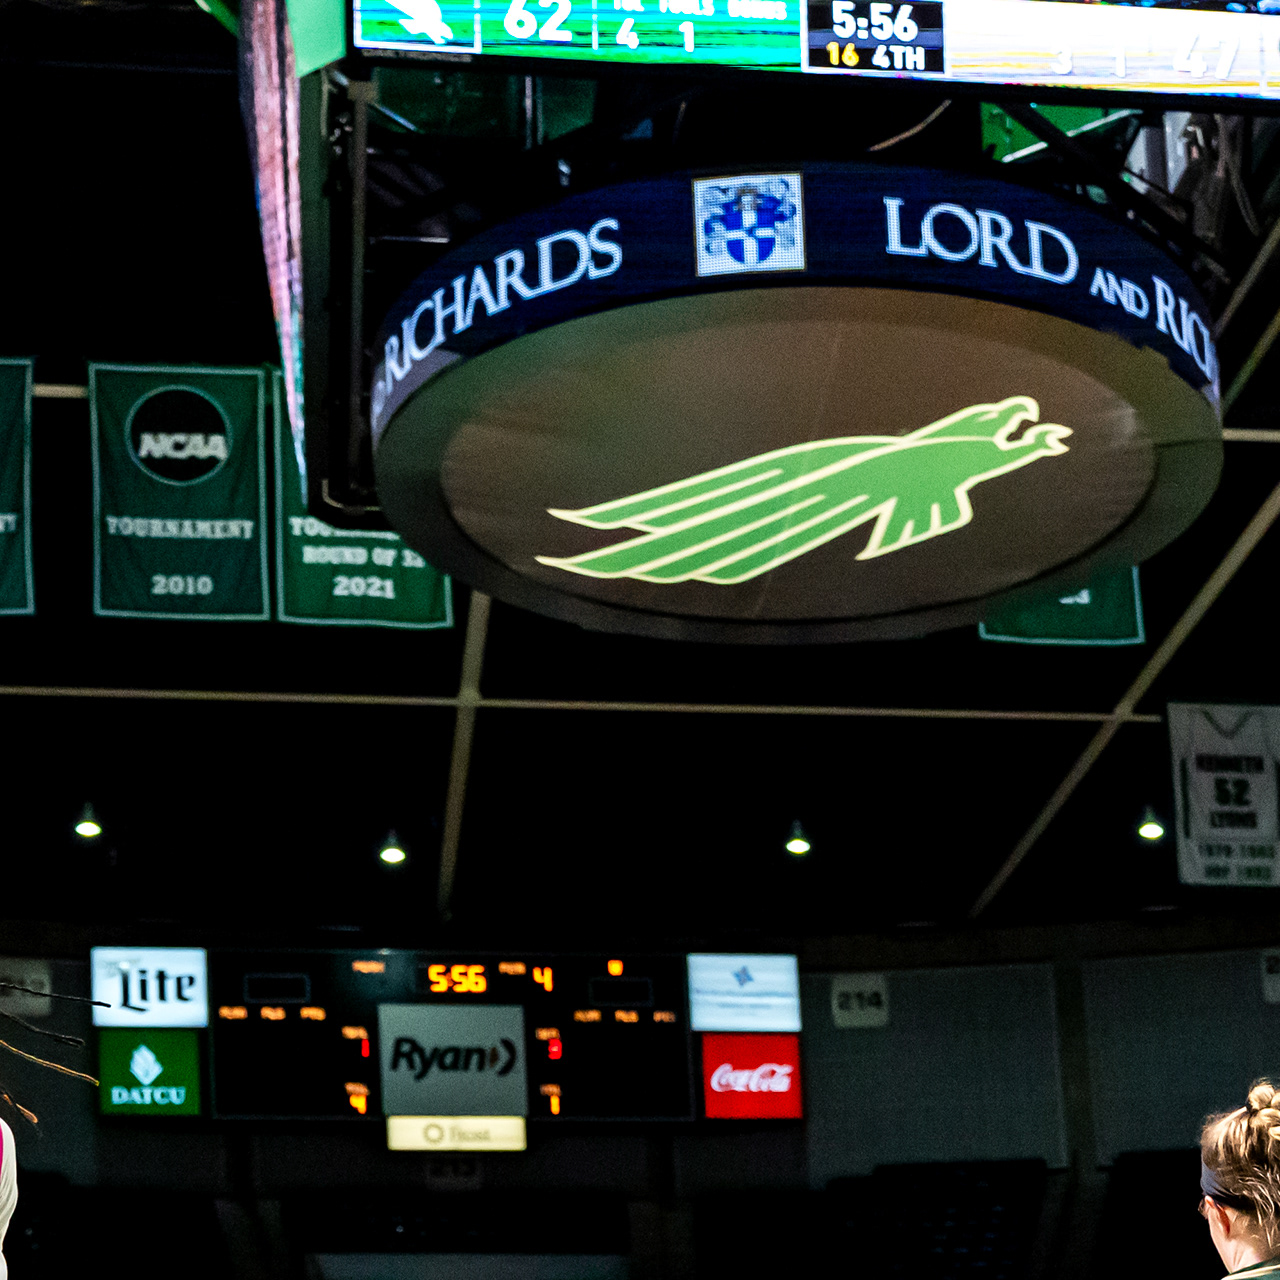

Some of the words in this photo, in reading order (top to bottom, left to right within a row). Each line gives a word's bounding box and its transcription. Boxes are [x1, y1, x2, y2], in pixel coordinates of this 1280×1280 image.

[503, 0, 572, 42] 62
[616, 17, 639, 49] 4
[678, 21, 694, 52] 1
[832, 1, 918, 42] 5:56
[826, 42, 859, 66] 16
[873, 43, 925, 70] 4TH
[883, 196, 1079, 285] LORD
[1090, 267, 1149, 319] AND
[384, 217, 622, 393] RICHARDS
[139, 432, 228, 459] NCAA
[106, 515, 254, 539] TOURNAMENT
[151, 575, 214, 596] 2010
[332, 575, 395, 599] 2021
[118, 968, 196, 1012] Lite
[532, 966, 554, 992] 4
[391, 1037, 486, 1082] Ryan
[111, 1086, 186, 1106] DATCU
